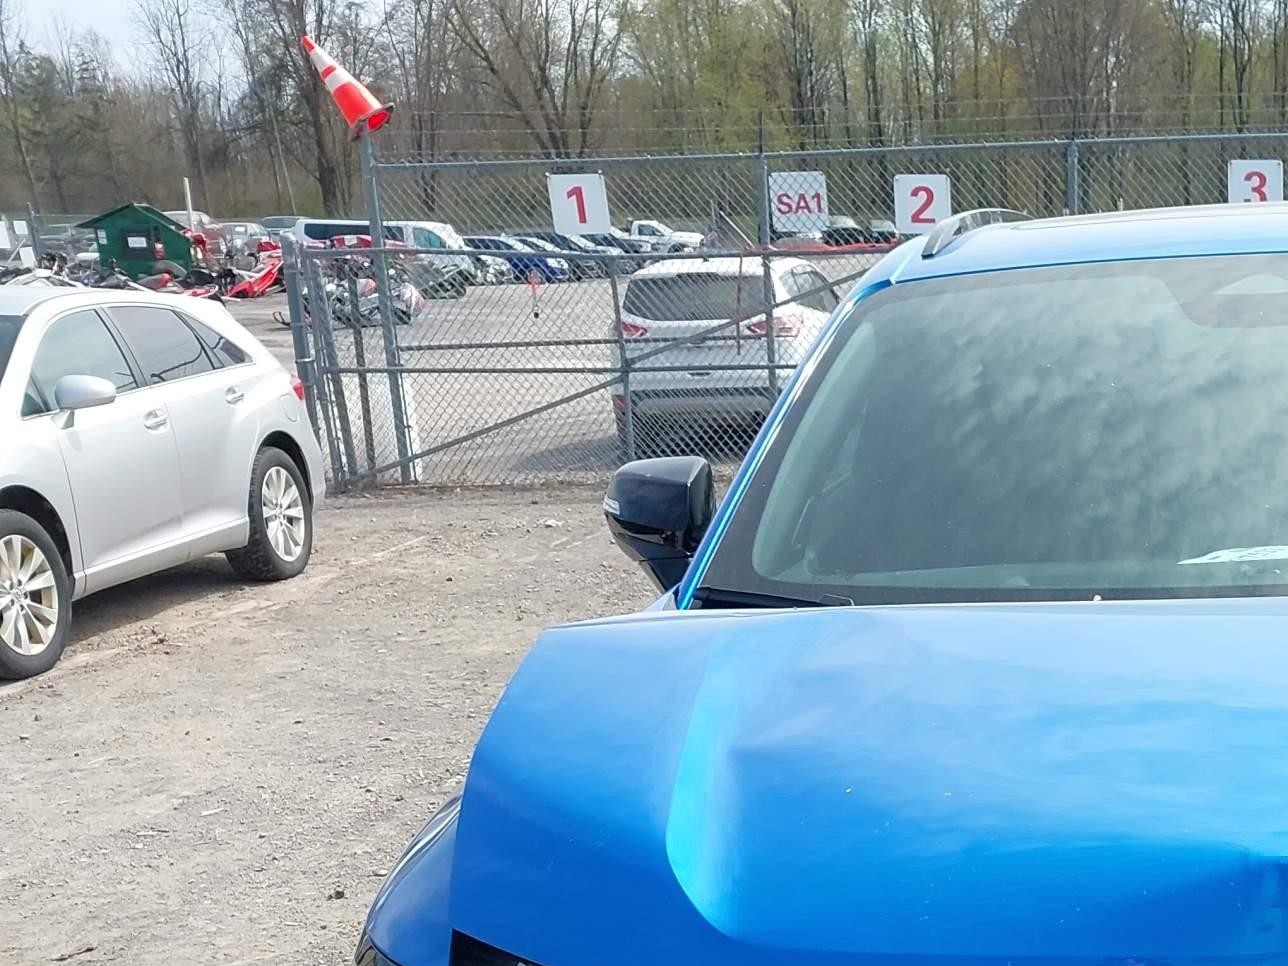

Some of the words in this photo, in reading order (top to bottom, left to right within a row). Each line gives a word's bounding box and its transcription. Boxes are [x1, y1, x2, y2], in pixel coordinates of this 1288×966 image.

[776, 192, 823, 215] SA1
[1244, 171, 1267, 202] 3
[566, 186, 587, 224] 1
[909, 186, 935, 224] 2
